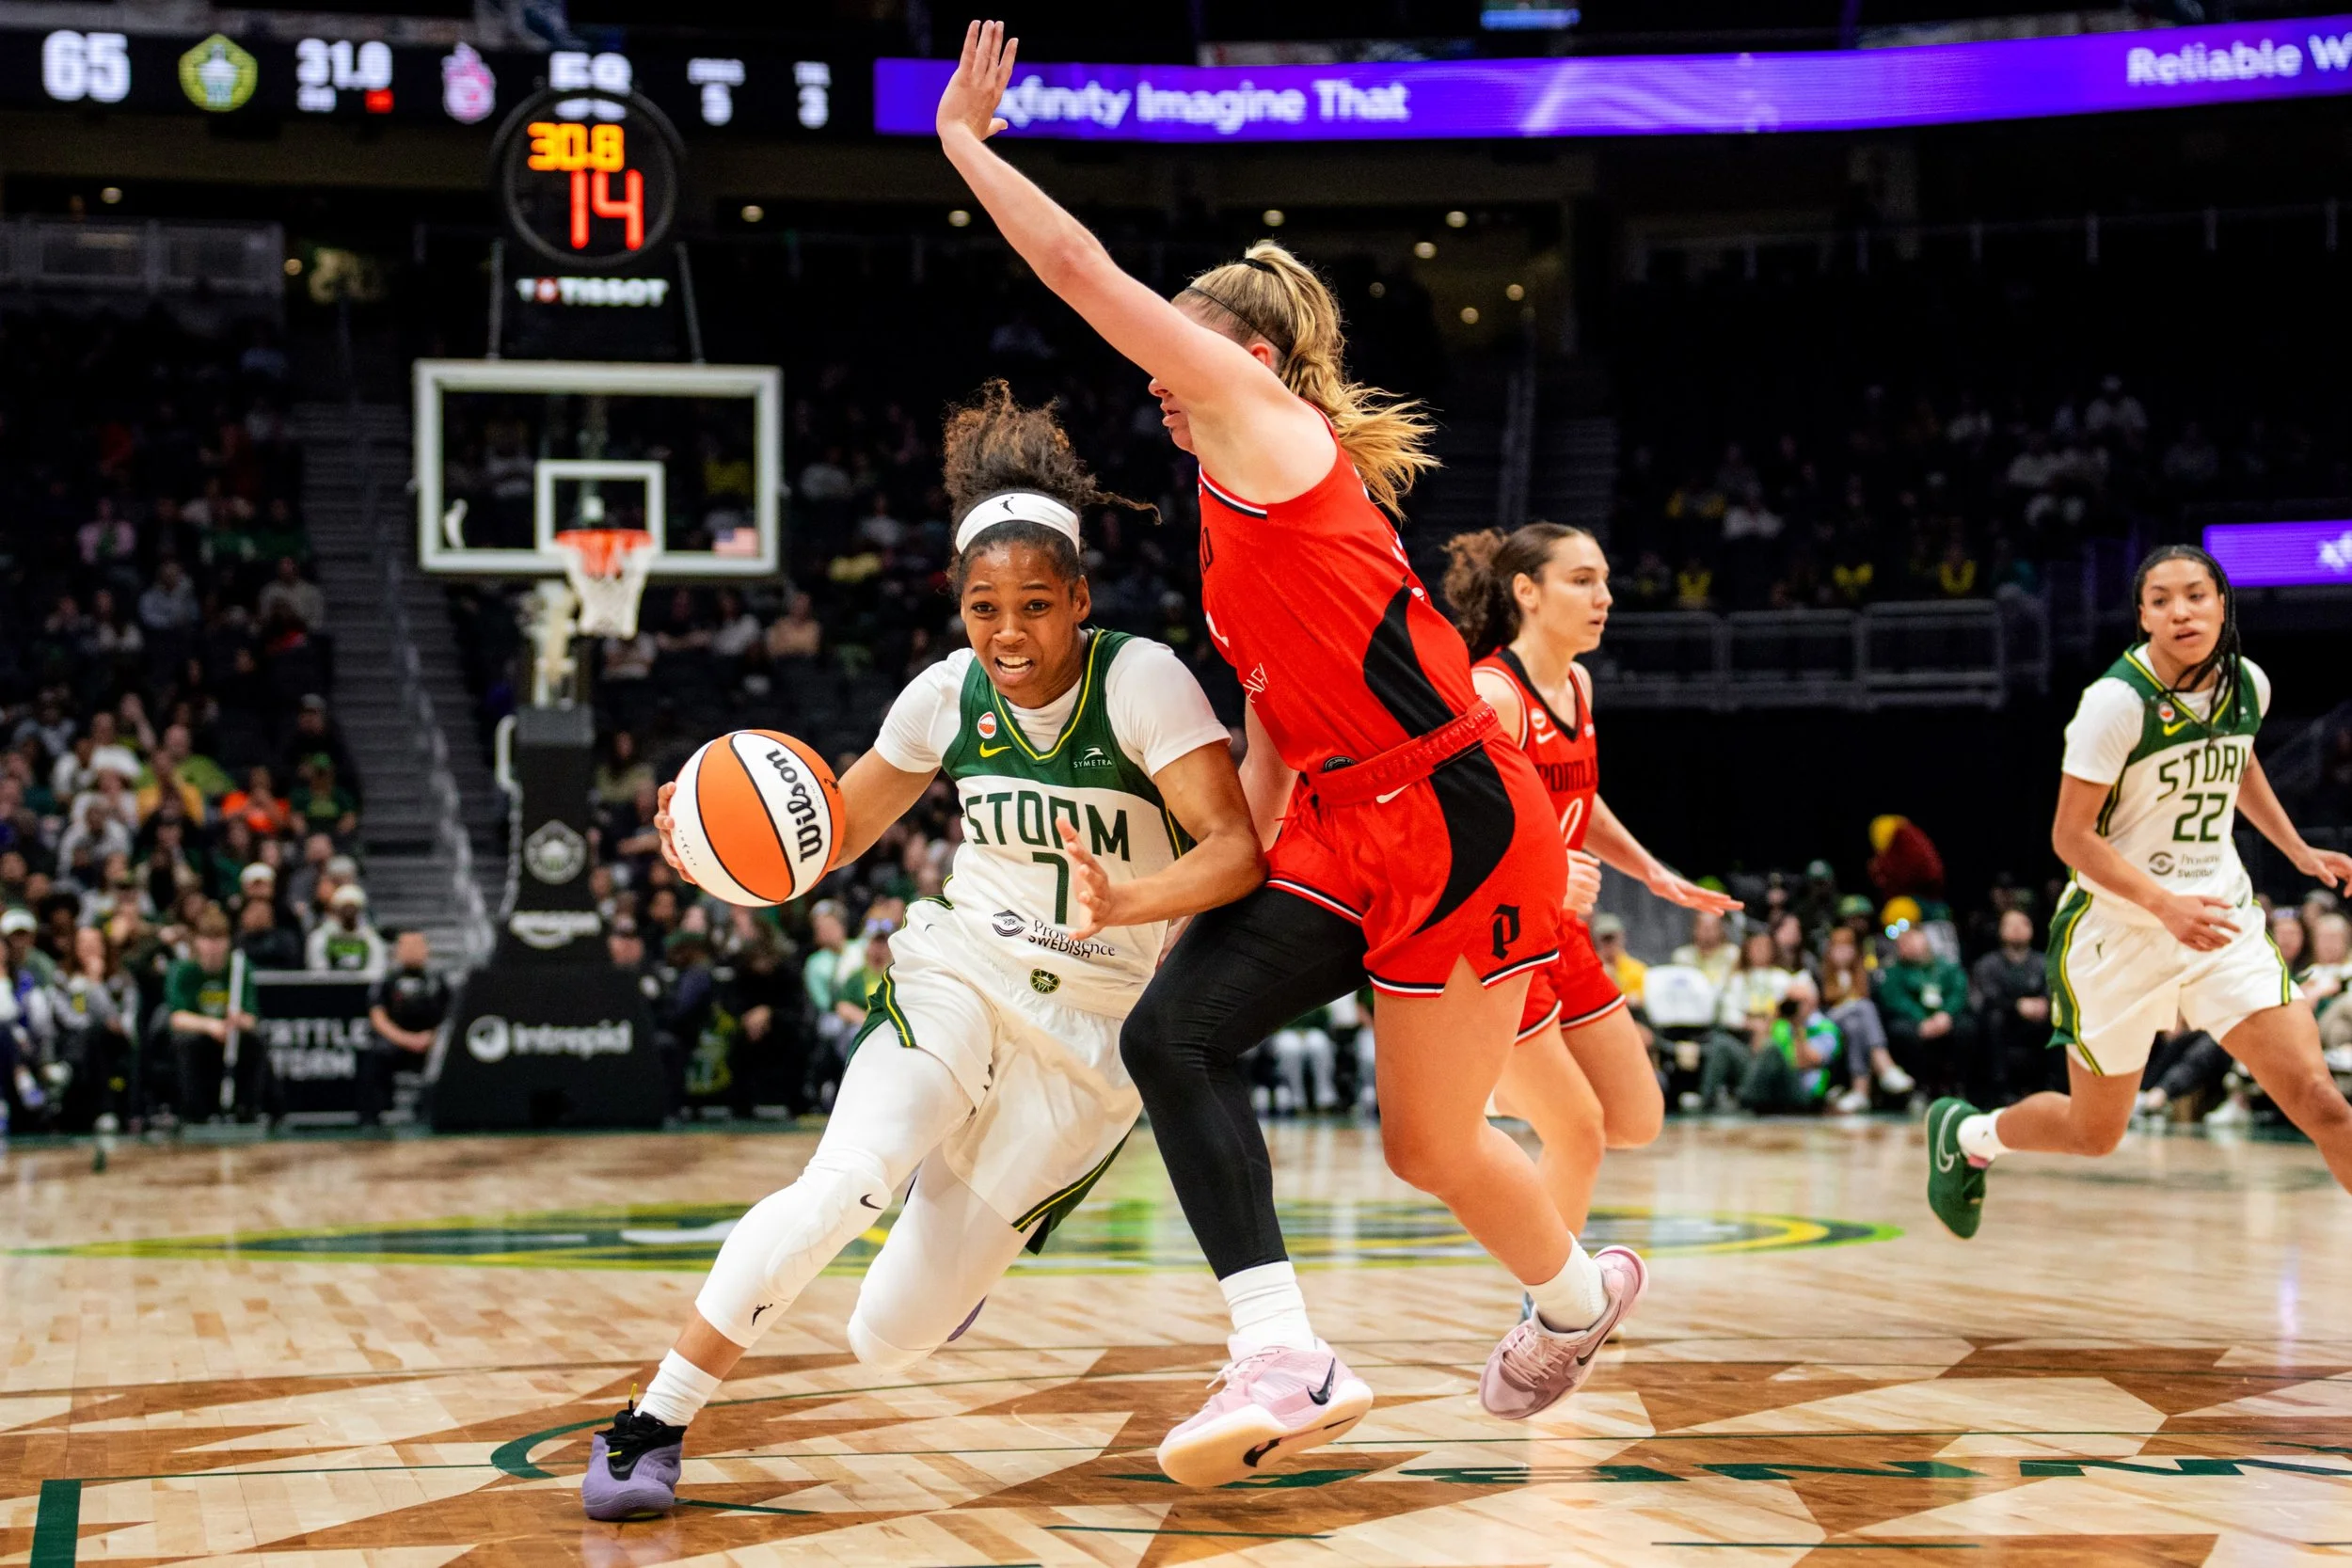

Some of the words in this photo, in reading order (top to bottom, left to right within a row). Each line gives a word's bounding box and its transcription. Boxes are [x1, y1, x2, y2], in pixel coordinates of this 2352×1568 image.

[41, 29, 131, 103] 65
[2126, 38, 2302, 87] Reliable
[1136, 79, 1308, 135] Imagine
[1310, 79, 1409, 122] That
[570, 169, 644, 251] 14
[1073, 758, 1113, 768] SYMETRA
[2156, 744, 2248, 801] STOR
[766, 748, 823, 863] Wilson
[964, 790, 1131, 863] STORM
[2172, 793, 2229, 842] 22
[1031, 850, 1070, 925] 7
